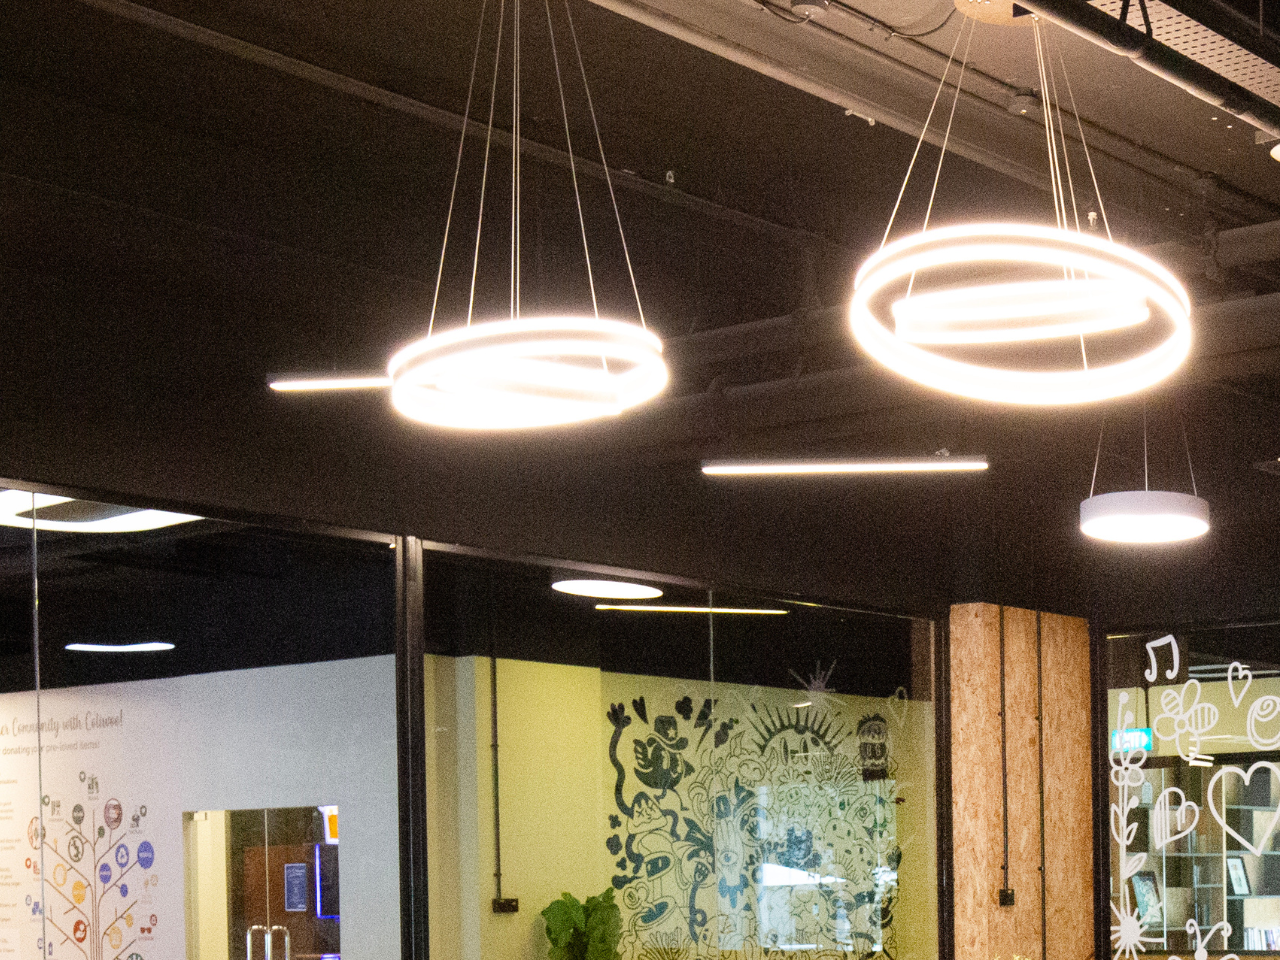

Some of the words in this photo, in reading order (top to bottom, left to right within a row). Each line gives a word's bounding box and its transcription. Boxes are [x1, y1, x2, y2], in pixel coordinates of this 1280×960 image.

[12, 716, 60, 738] Commnity
[62, 714, 82, 731] with
[2, 744, 30, 756] donating
[31, 745, 44, 755] yor
